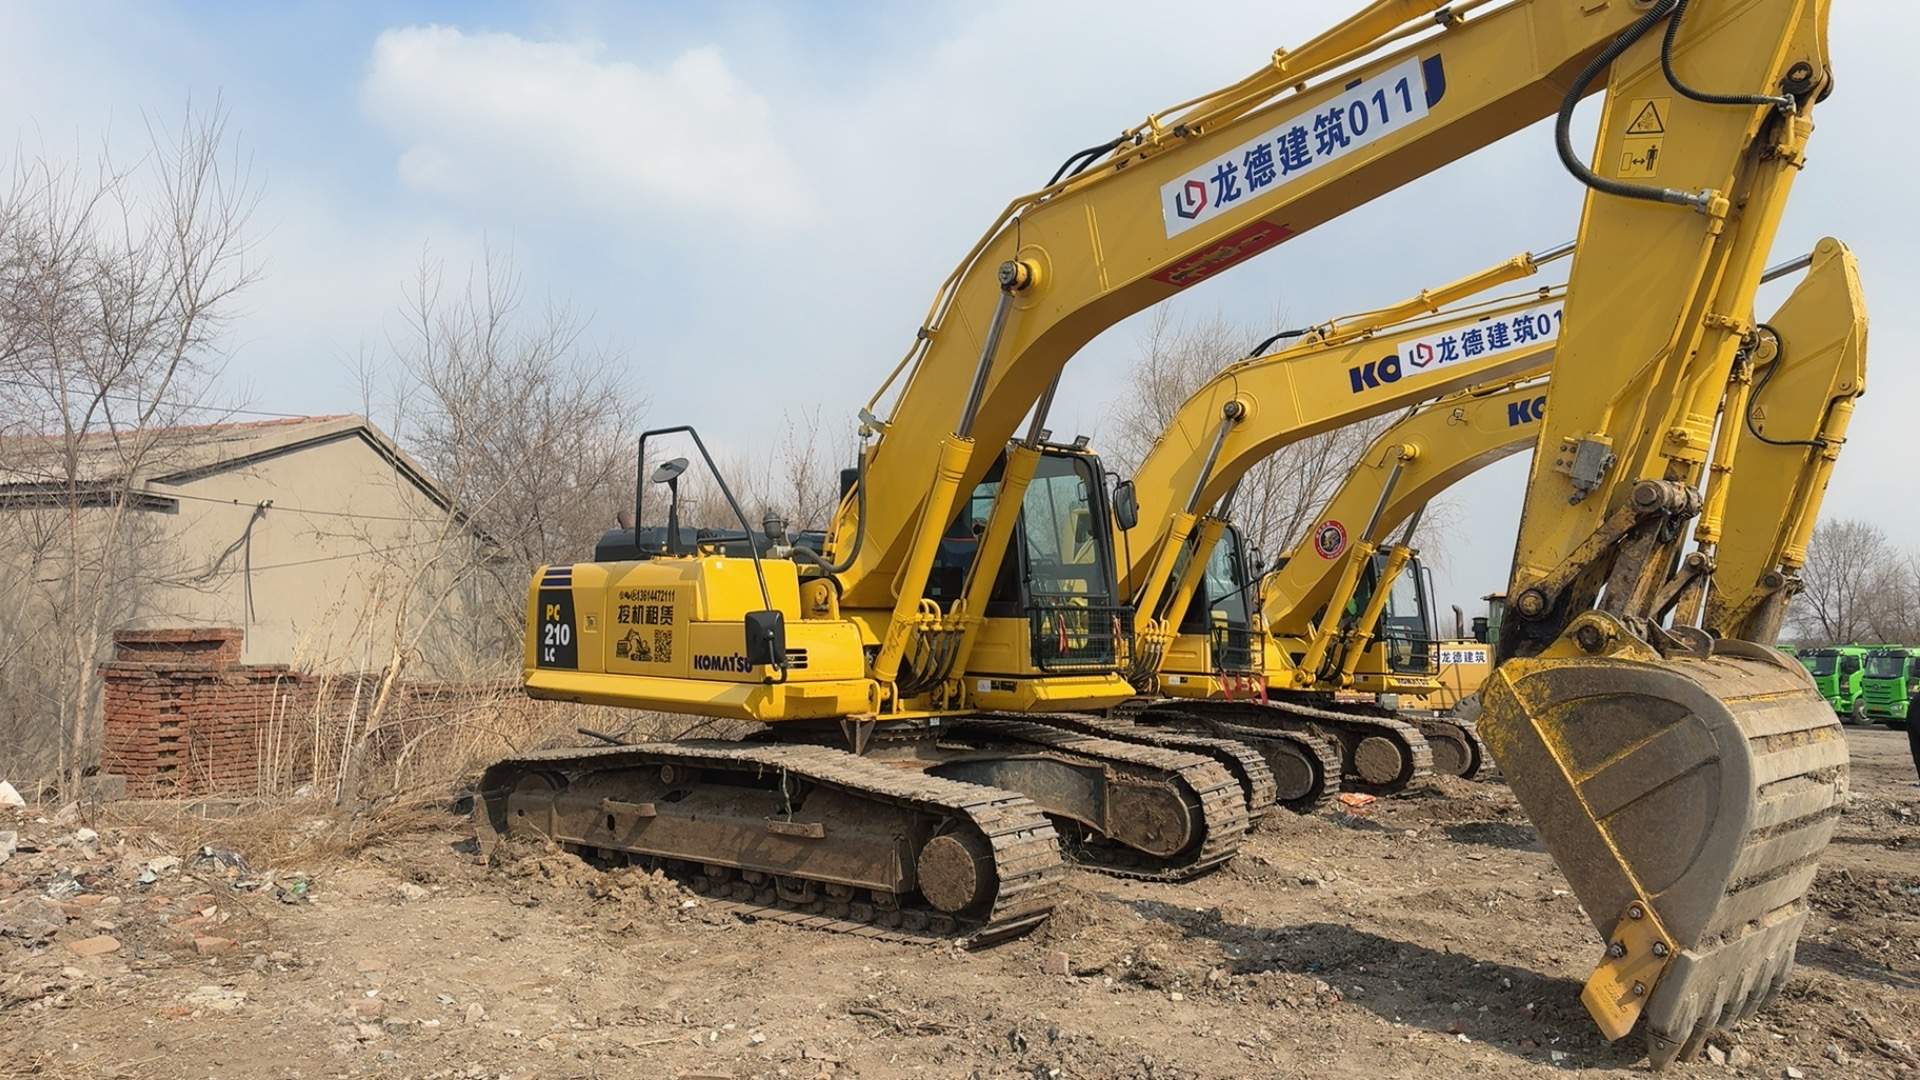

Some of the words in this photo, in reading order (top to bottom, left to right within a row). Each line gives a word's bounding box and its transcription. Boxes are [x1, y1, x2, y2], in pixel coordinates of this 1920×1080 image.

[1210, 77, 1413, 208] 龙德建筑011
[545, 604, 560, 621] PC
[617, 604, 674, 626] 挖机租赁
[544, 623, 570, 646] 210
[544, 647, 556, 662] LC
[694, 652, 753, 673] KOMATSU
[1441, 651, 1486, 663] 龙德建筑
